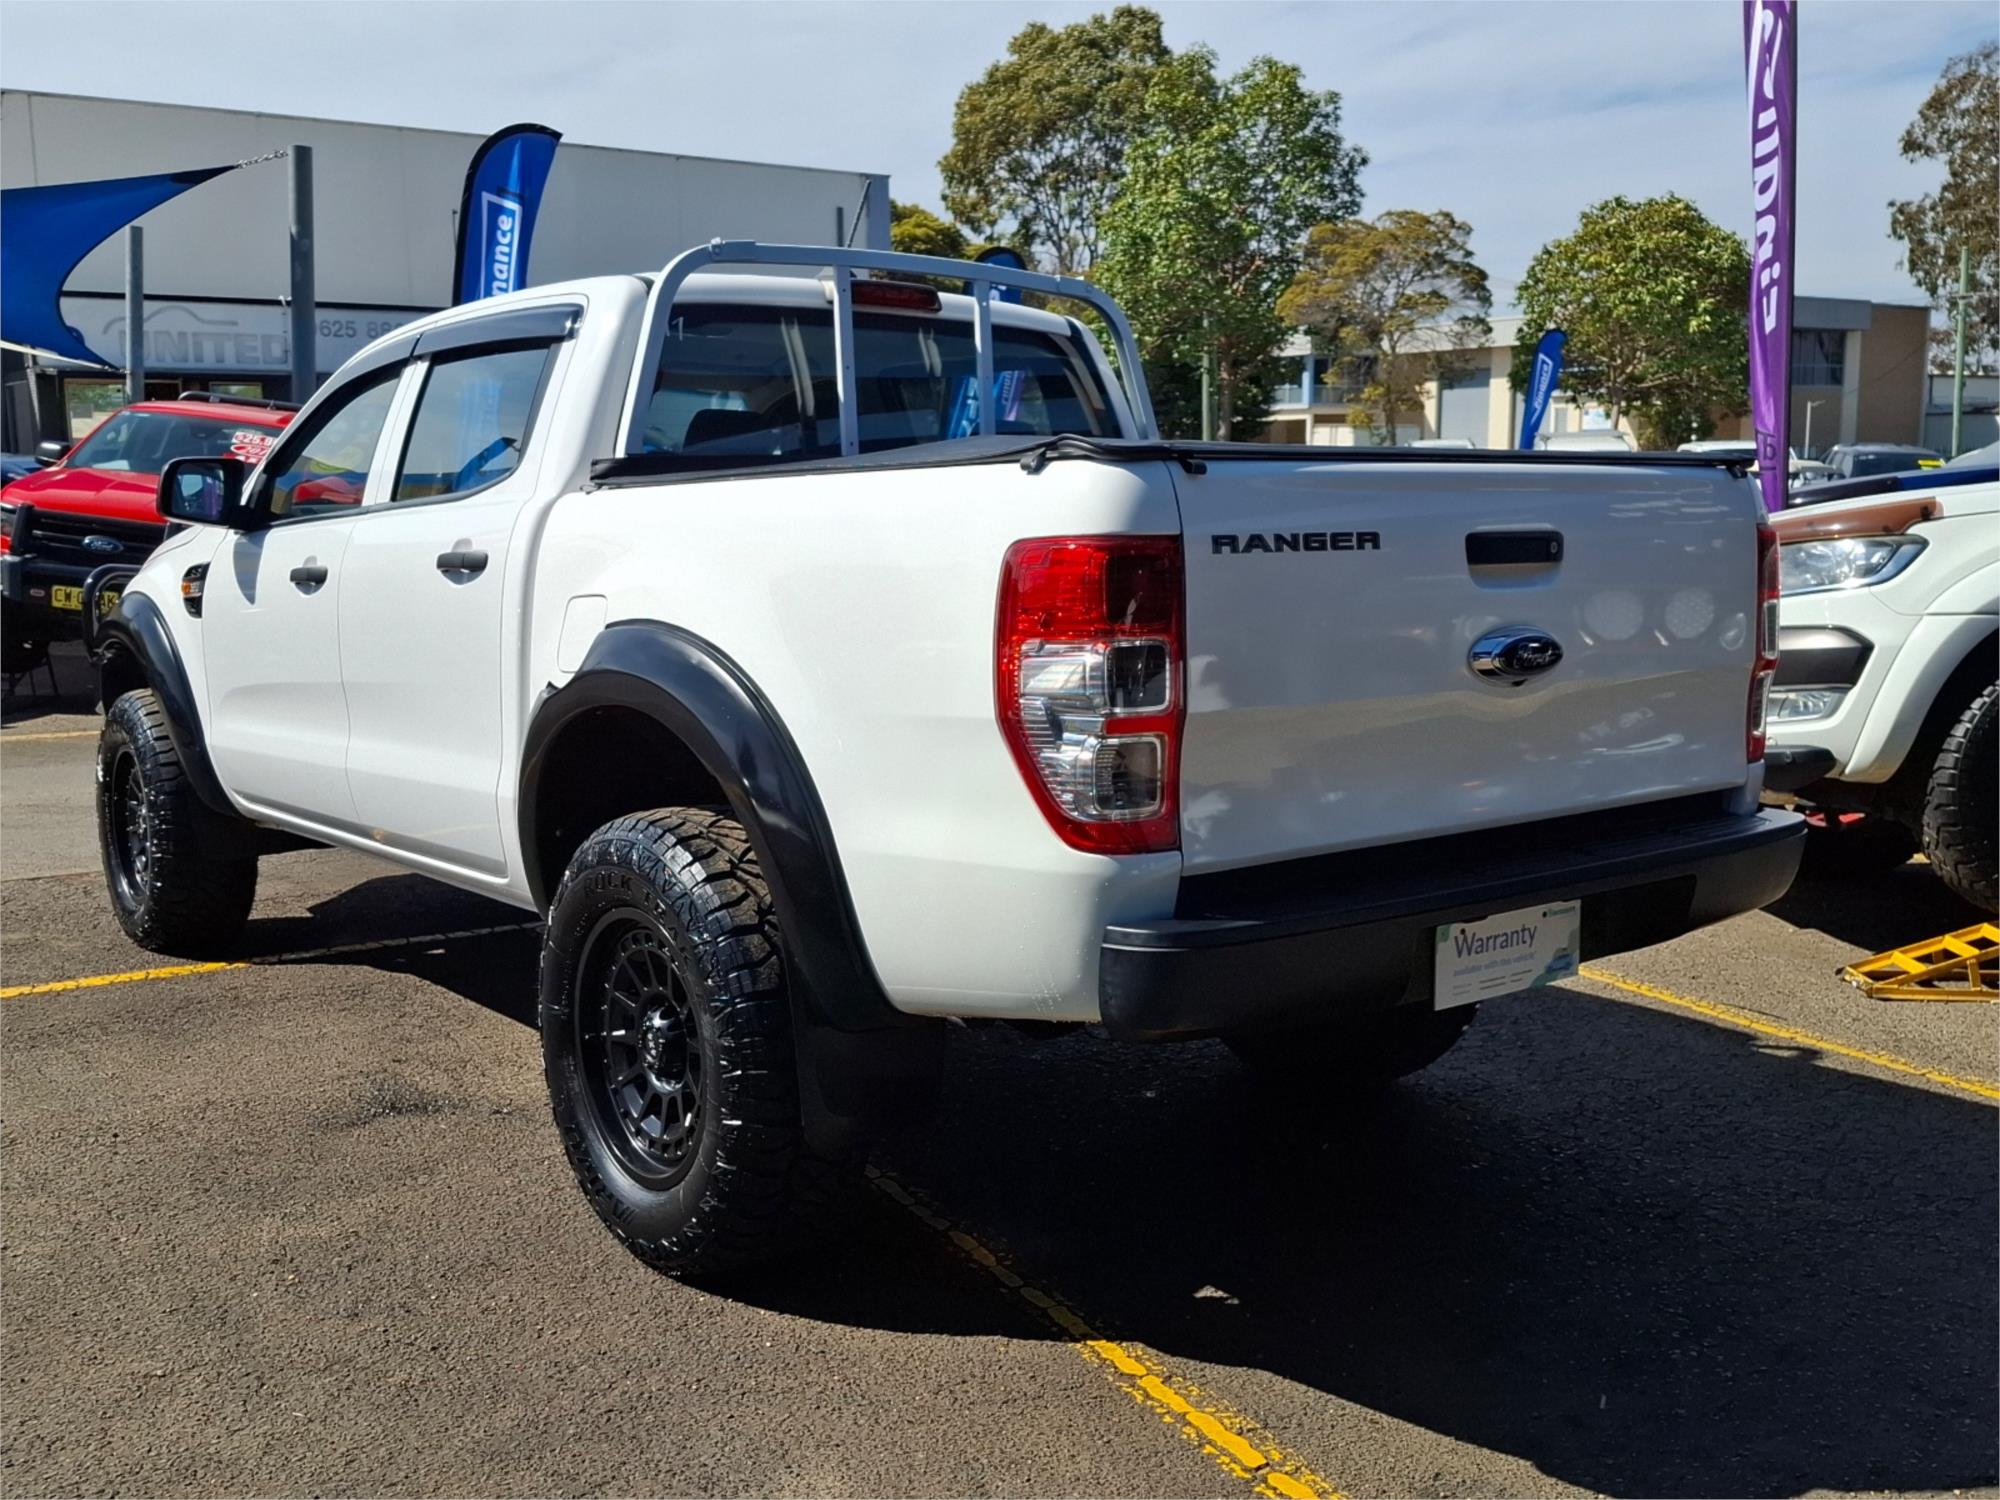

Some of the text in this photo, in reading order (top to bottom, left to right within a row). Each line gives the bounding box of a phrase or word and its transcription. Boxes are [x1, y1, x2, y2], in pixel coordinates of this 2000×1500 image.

[1211, 531, 1381, 554] RANGER
[584, 870, 633, 896] ROCK
[1453, 923, 1538, 959] Warranty
